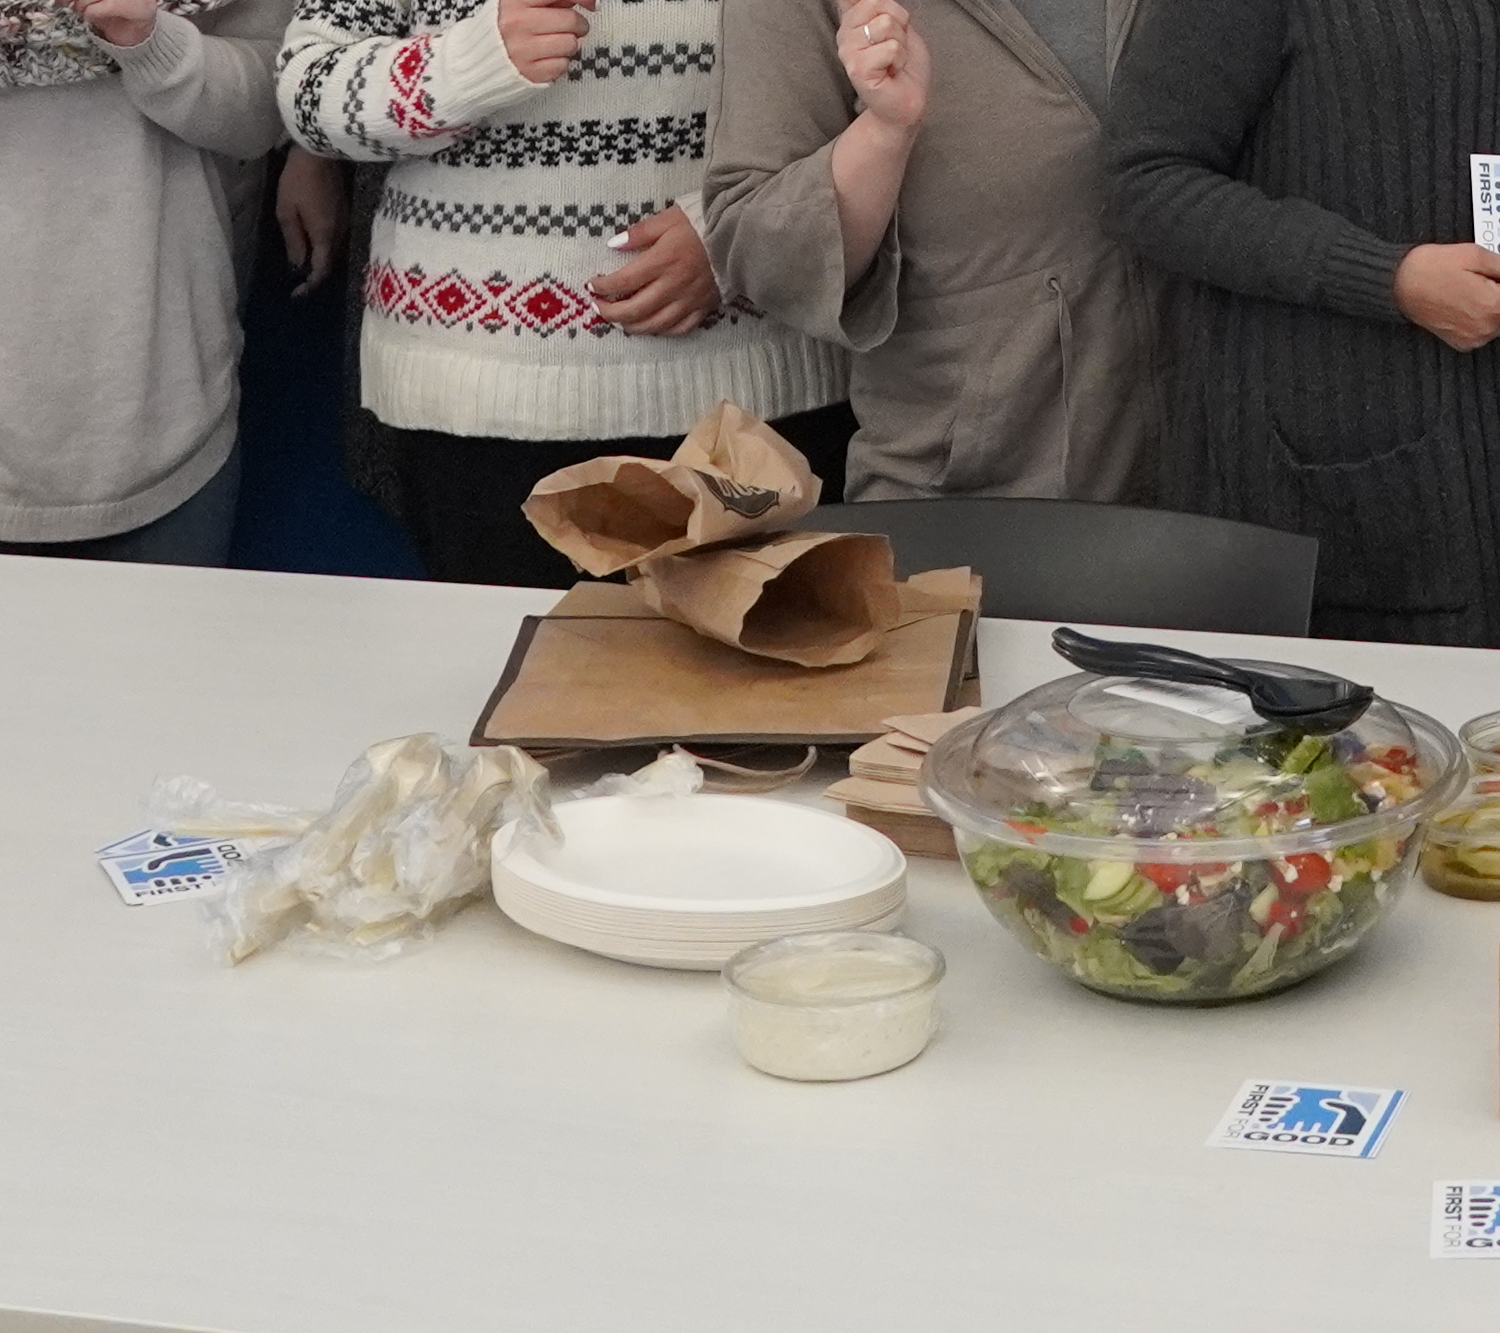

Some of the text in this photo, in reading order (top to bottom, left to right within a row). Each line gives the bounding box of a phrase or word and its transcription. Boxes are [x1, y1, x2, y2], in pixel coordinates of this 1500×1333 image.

[1478, 163, 1492, 215] FIRST
[134, 883, 204, 897] FIRST
[1222, 1084, 1270, 1139] FIRST FOR
[1244, 1131, 1355, 1147] GOOD
[1443, 1185, 1463, 1248] FIRST FOR
